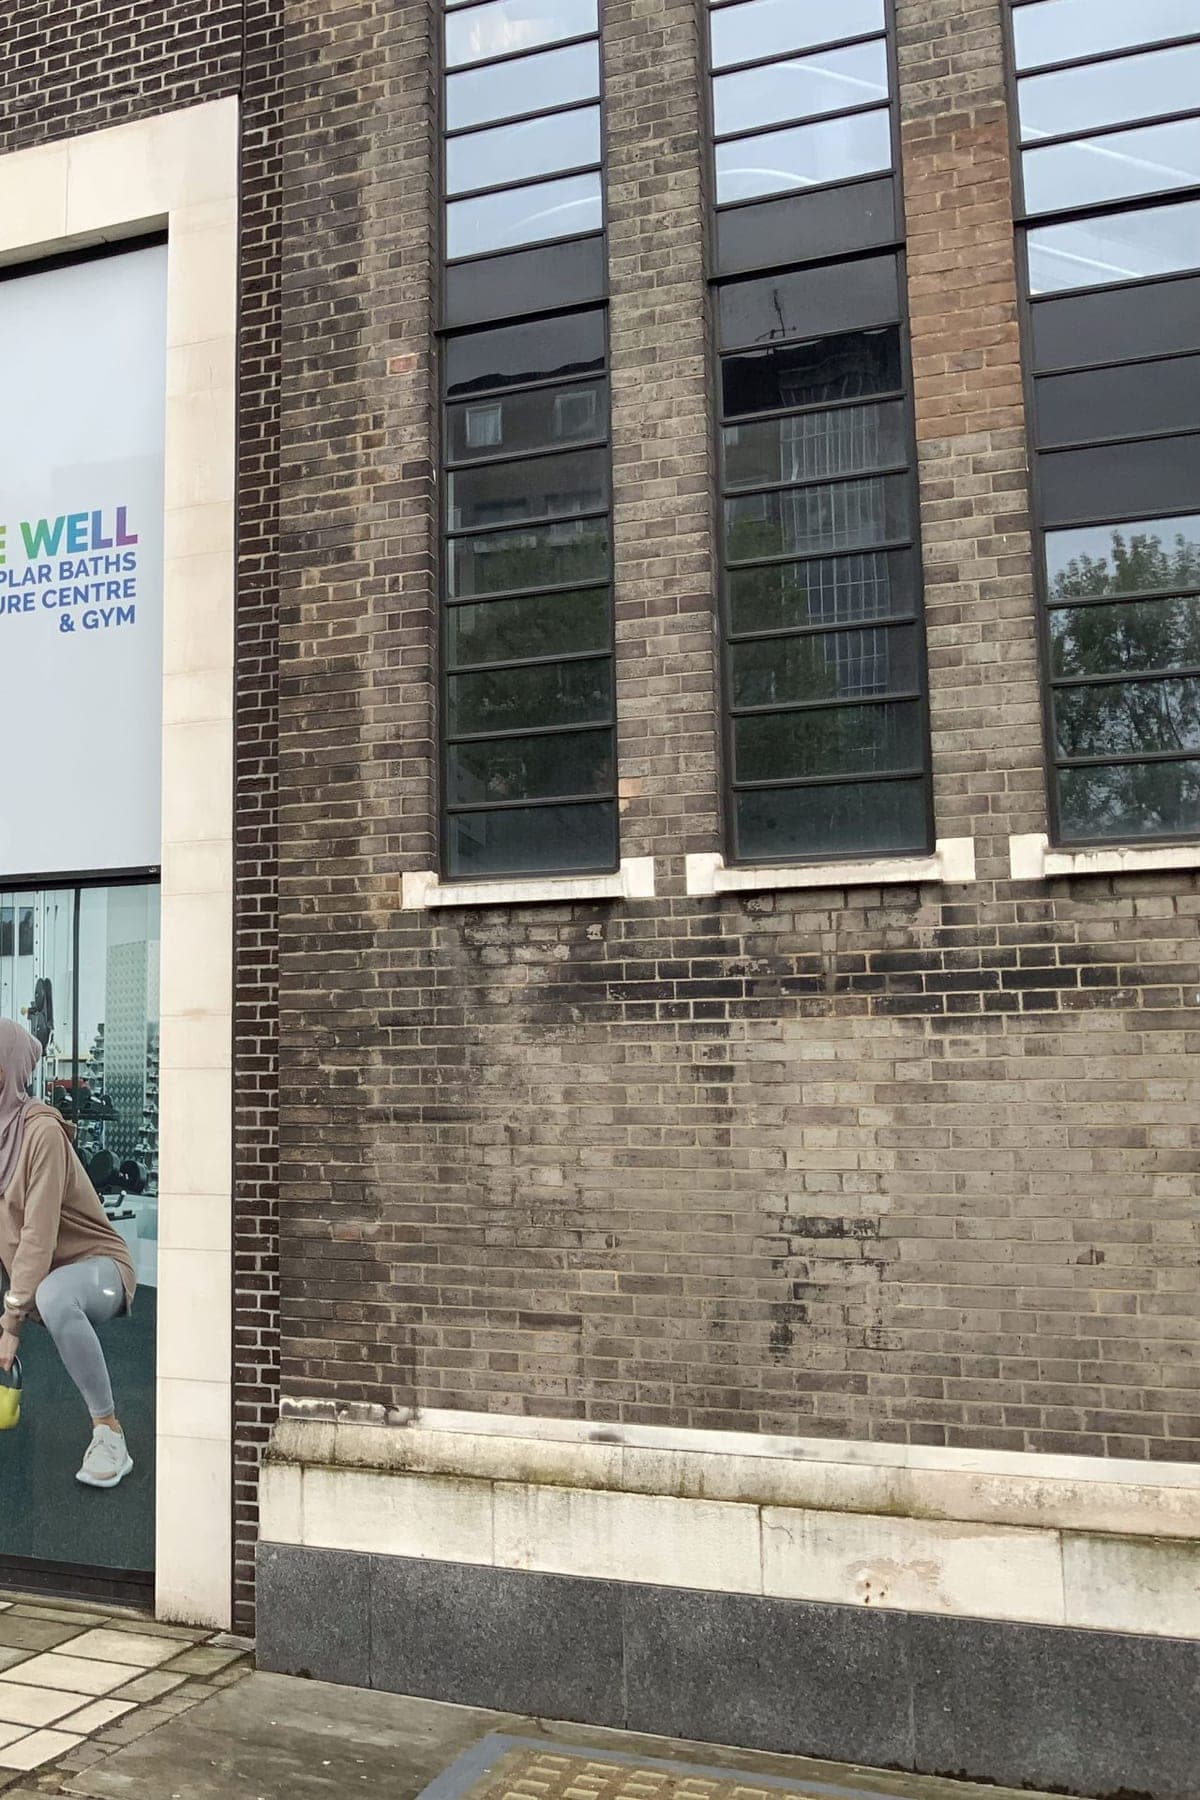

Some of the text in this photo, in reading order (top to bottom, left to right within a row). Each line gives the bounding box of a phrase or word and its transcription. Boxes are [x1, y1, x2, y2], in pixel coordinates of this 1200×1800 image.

[20, 506, 138, 560] WELL
[59, 552, 137, 580] BATHS
[42, 578, 137, 609] CENTRE
[59, 605, 136, 633] & GYM
